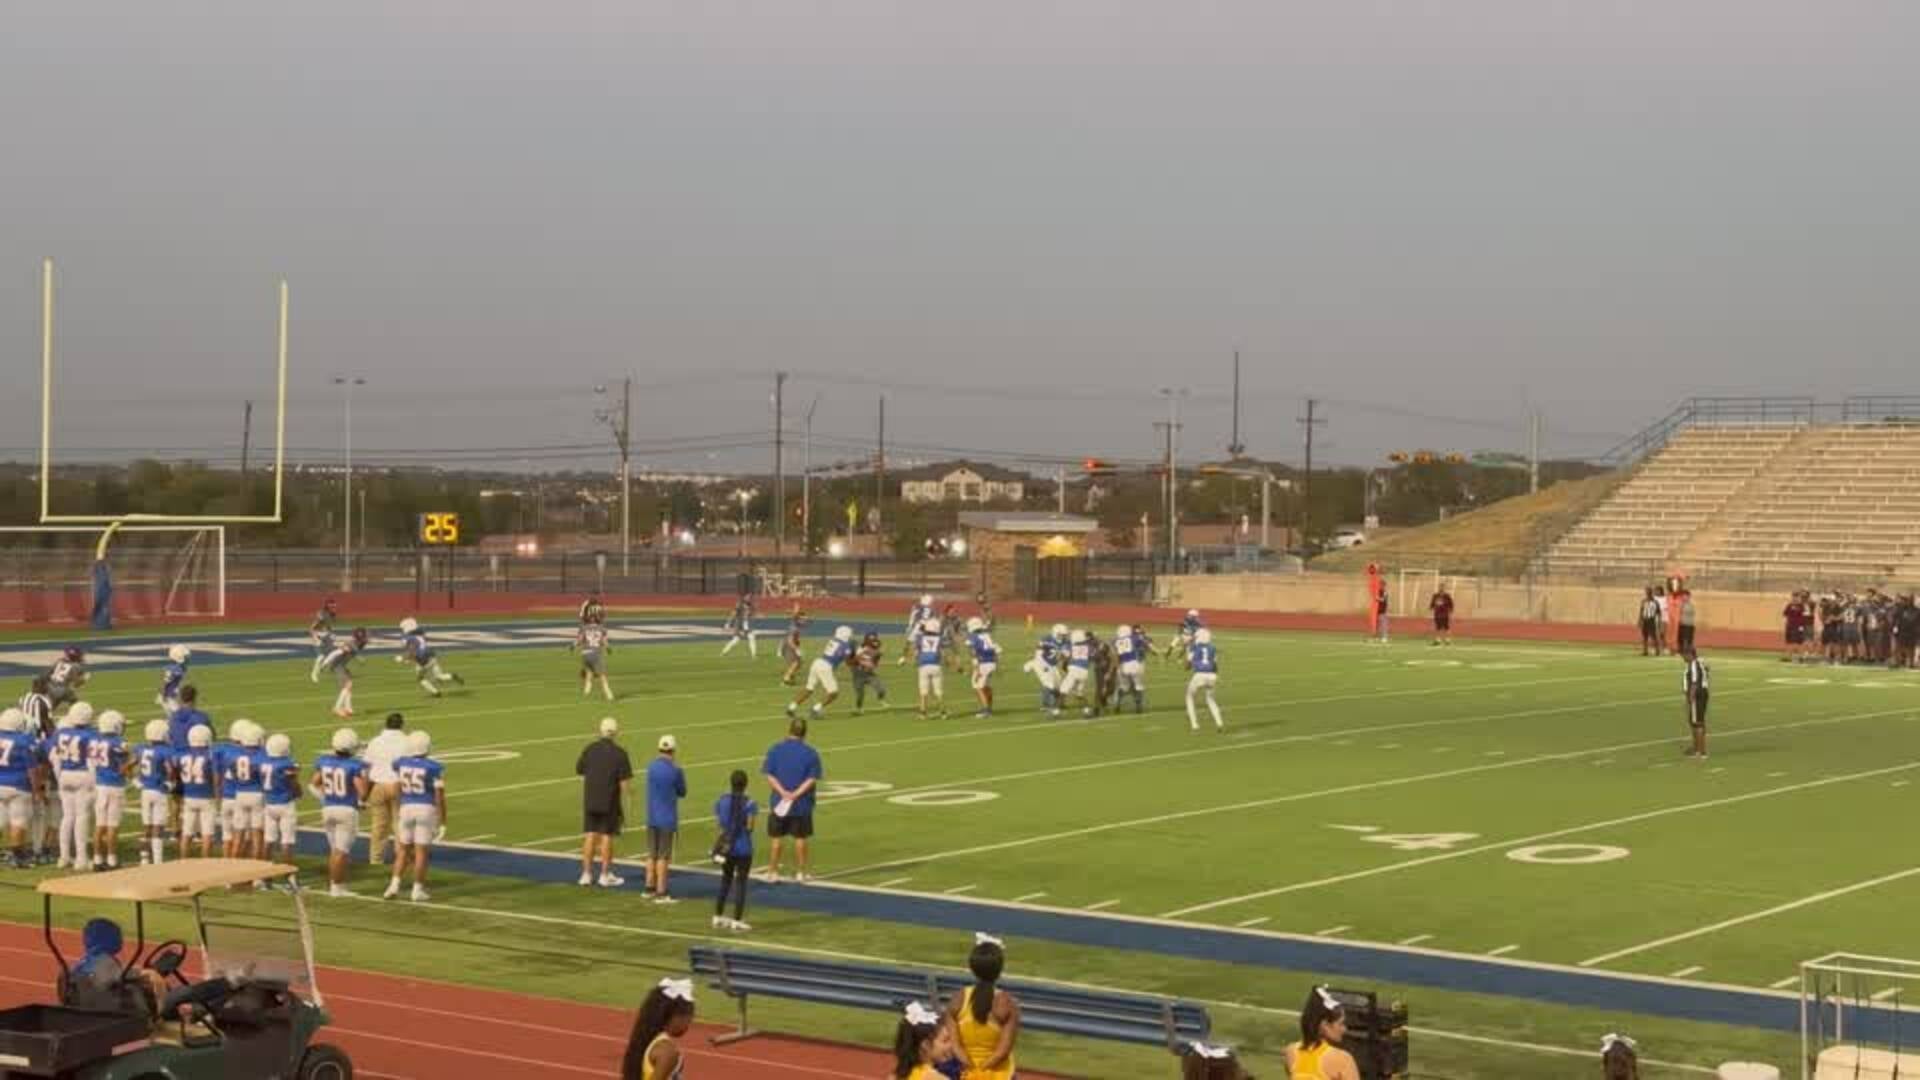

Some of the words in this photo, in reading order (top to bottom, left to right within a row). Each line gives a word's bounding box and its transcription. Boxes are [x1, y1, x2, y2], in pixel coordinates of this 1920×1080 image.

[425, 511, 458, 543] 25
[1201, 647, 1209, 665] 1
[58, 734, 80, 762] 54
[140, 749, 155, 777] 5
[180, 755, 205, 784] 34
[236, 755, 251, 781] 8
[261, 763, 273, 791] 7
[321, 766, 346, 798] 50
[399, 766, 426, 795] 55
